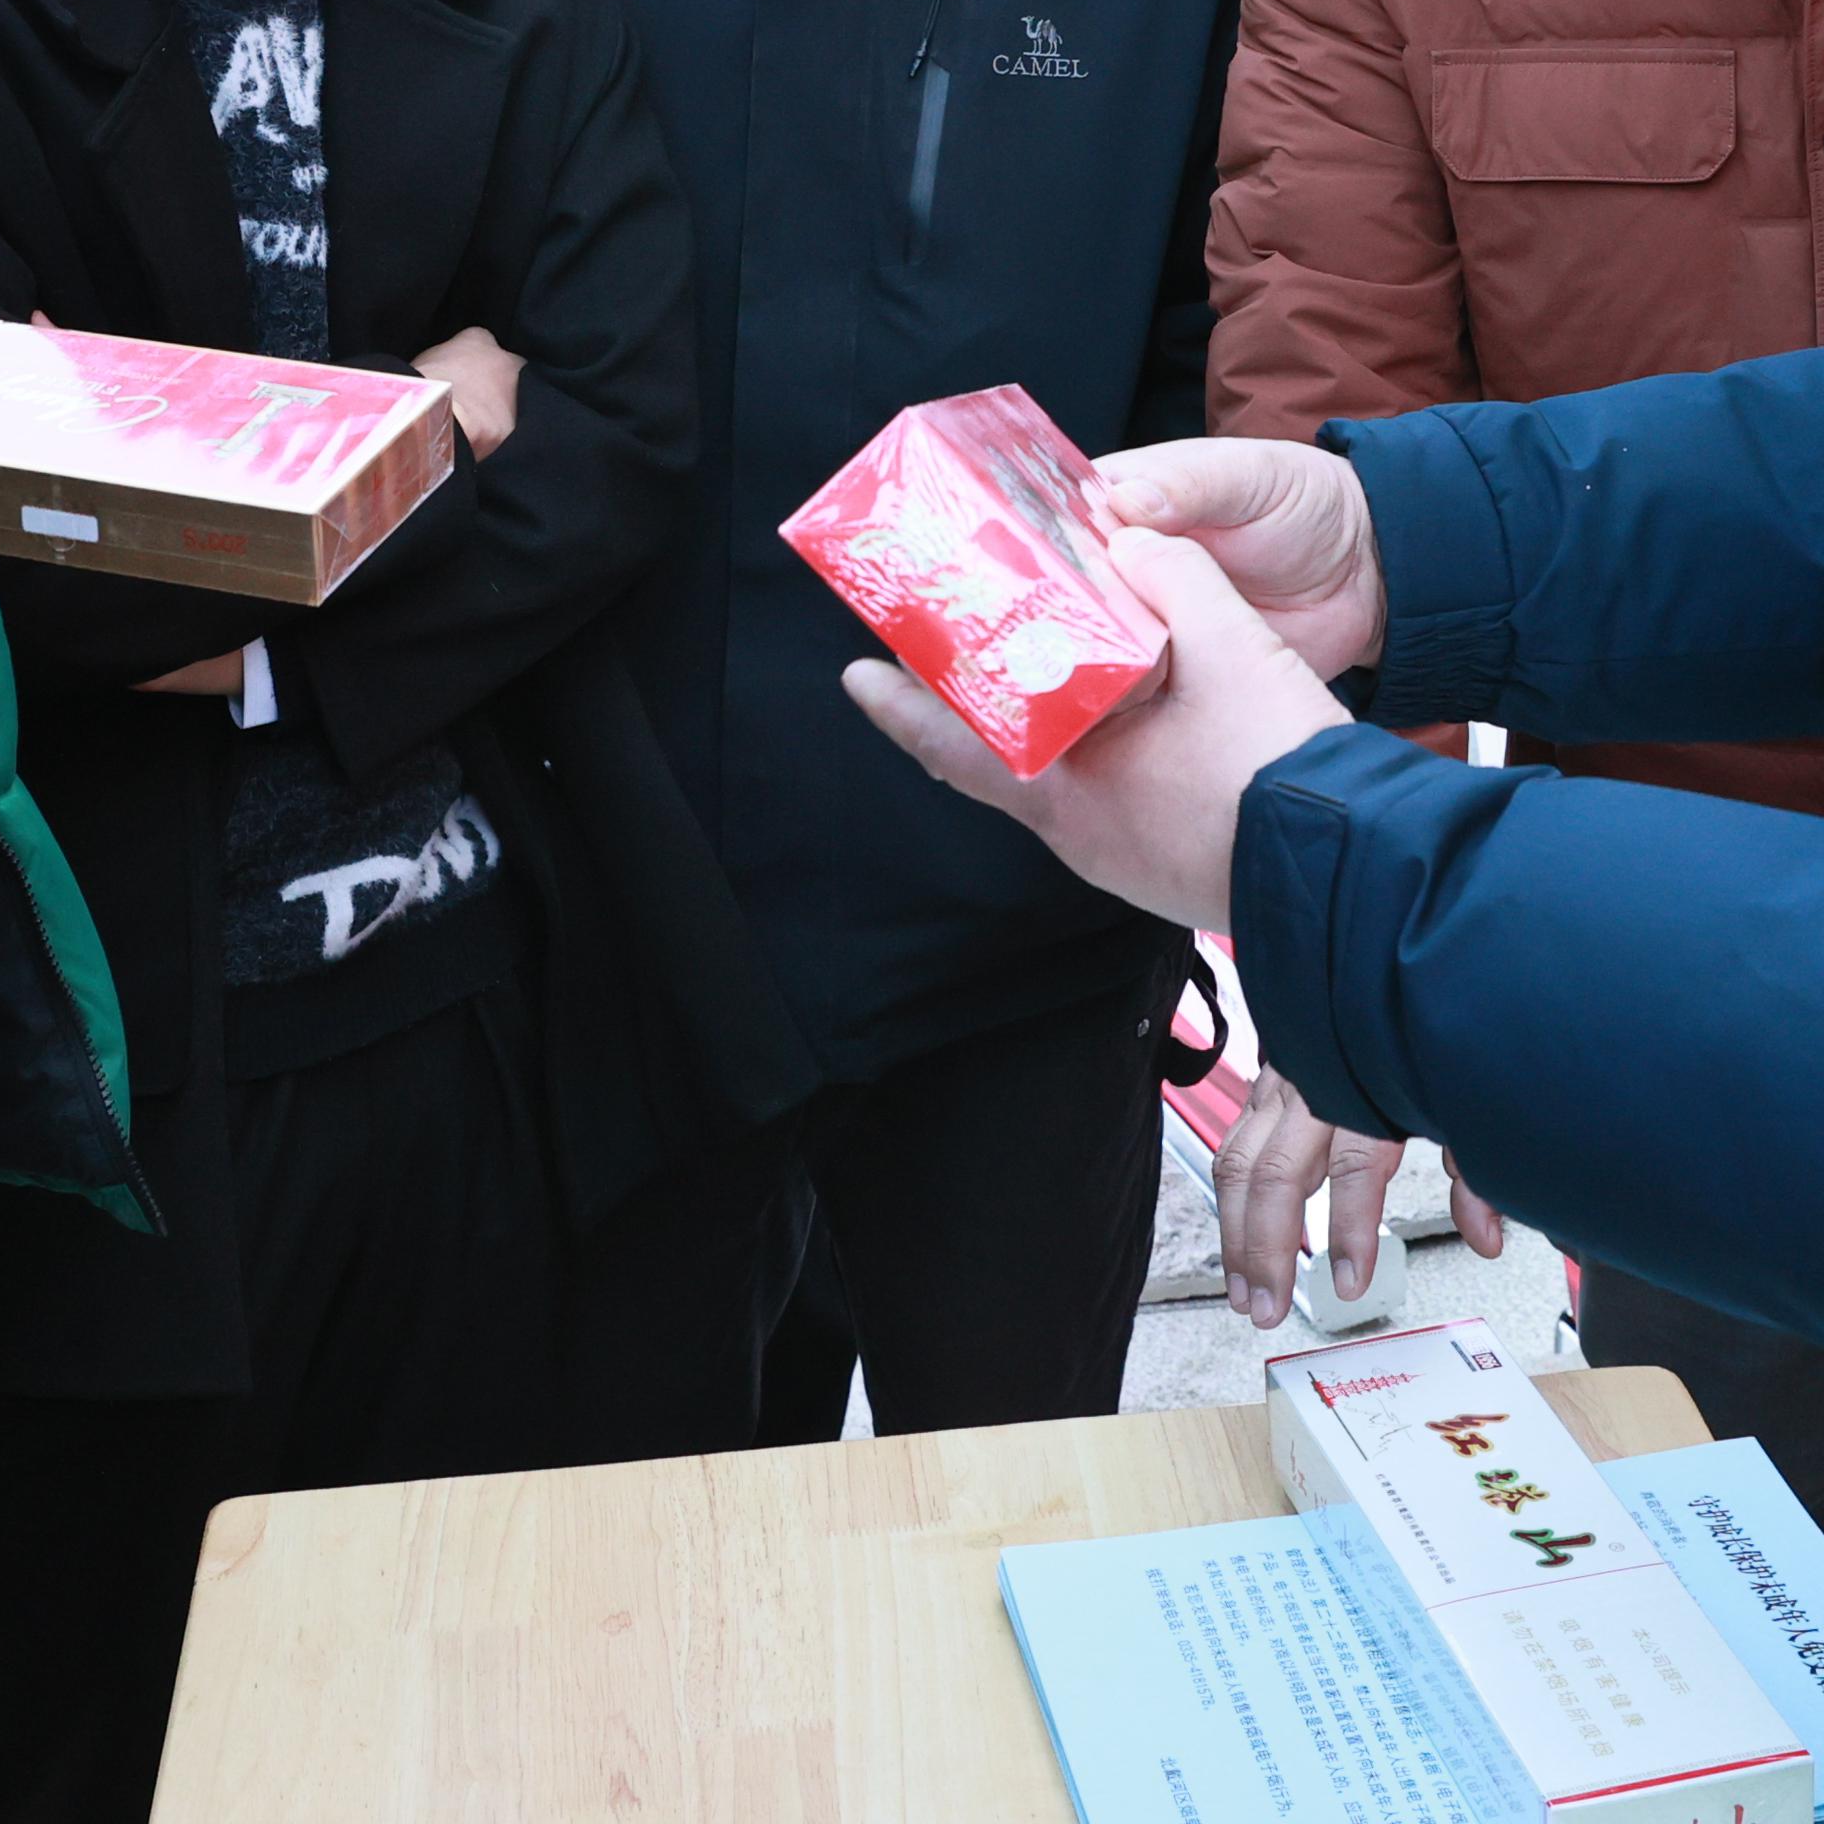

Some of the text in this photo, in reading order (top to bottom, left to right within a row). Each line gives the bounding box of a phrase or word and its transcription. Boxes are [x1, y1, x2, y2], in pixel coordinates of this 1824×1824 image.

[992, 54, 1089, 78] CAMEL
[1424, 1412, 1597, 1568] 红塔山
[1501, 1608, 1616, 1758] 请勿在禁烟场所吸烟
[1557, 1617, 1646, 1728] 吸烟有害健康
[1631, 1627, 1691, 1695] 本公司提示
